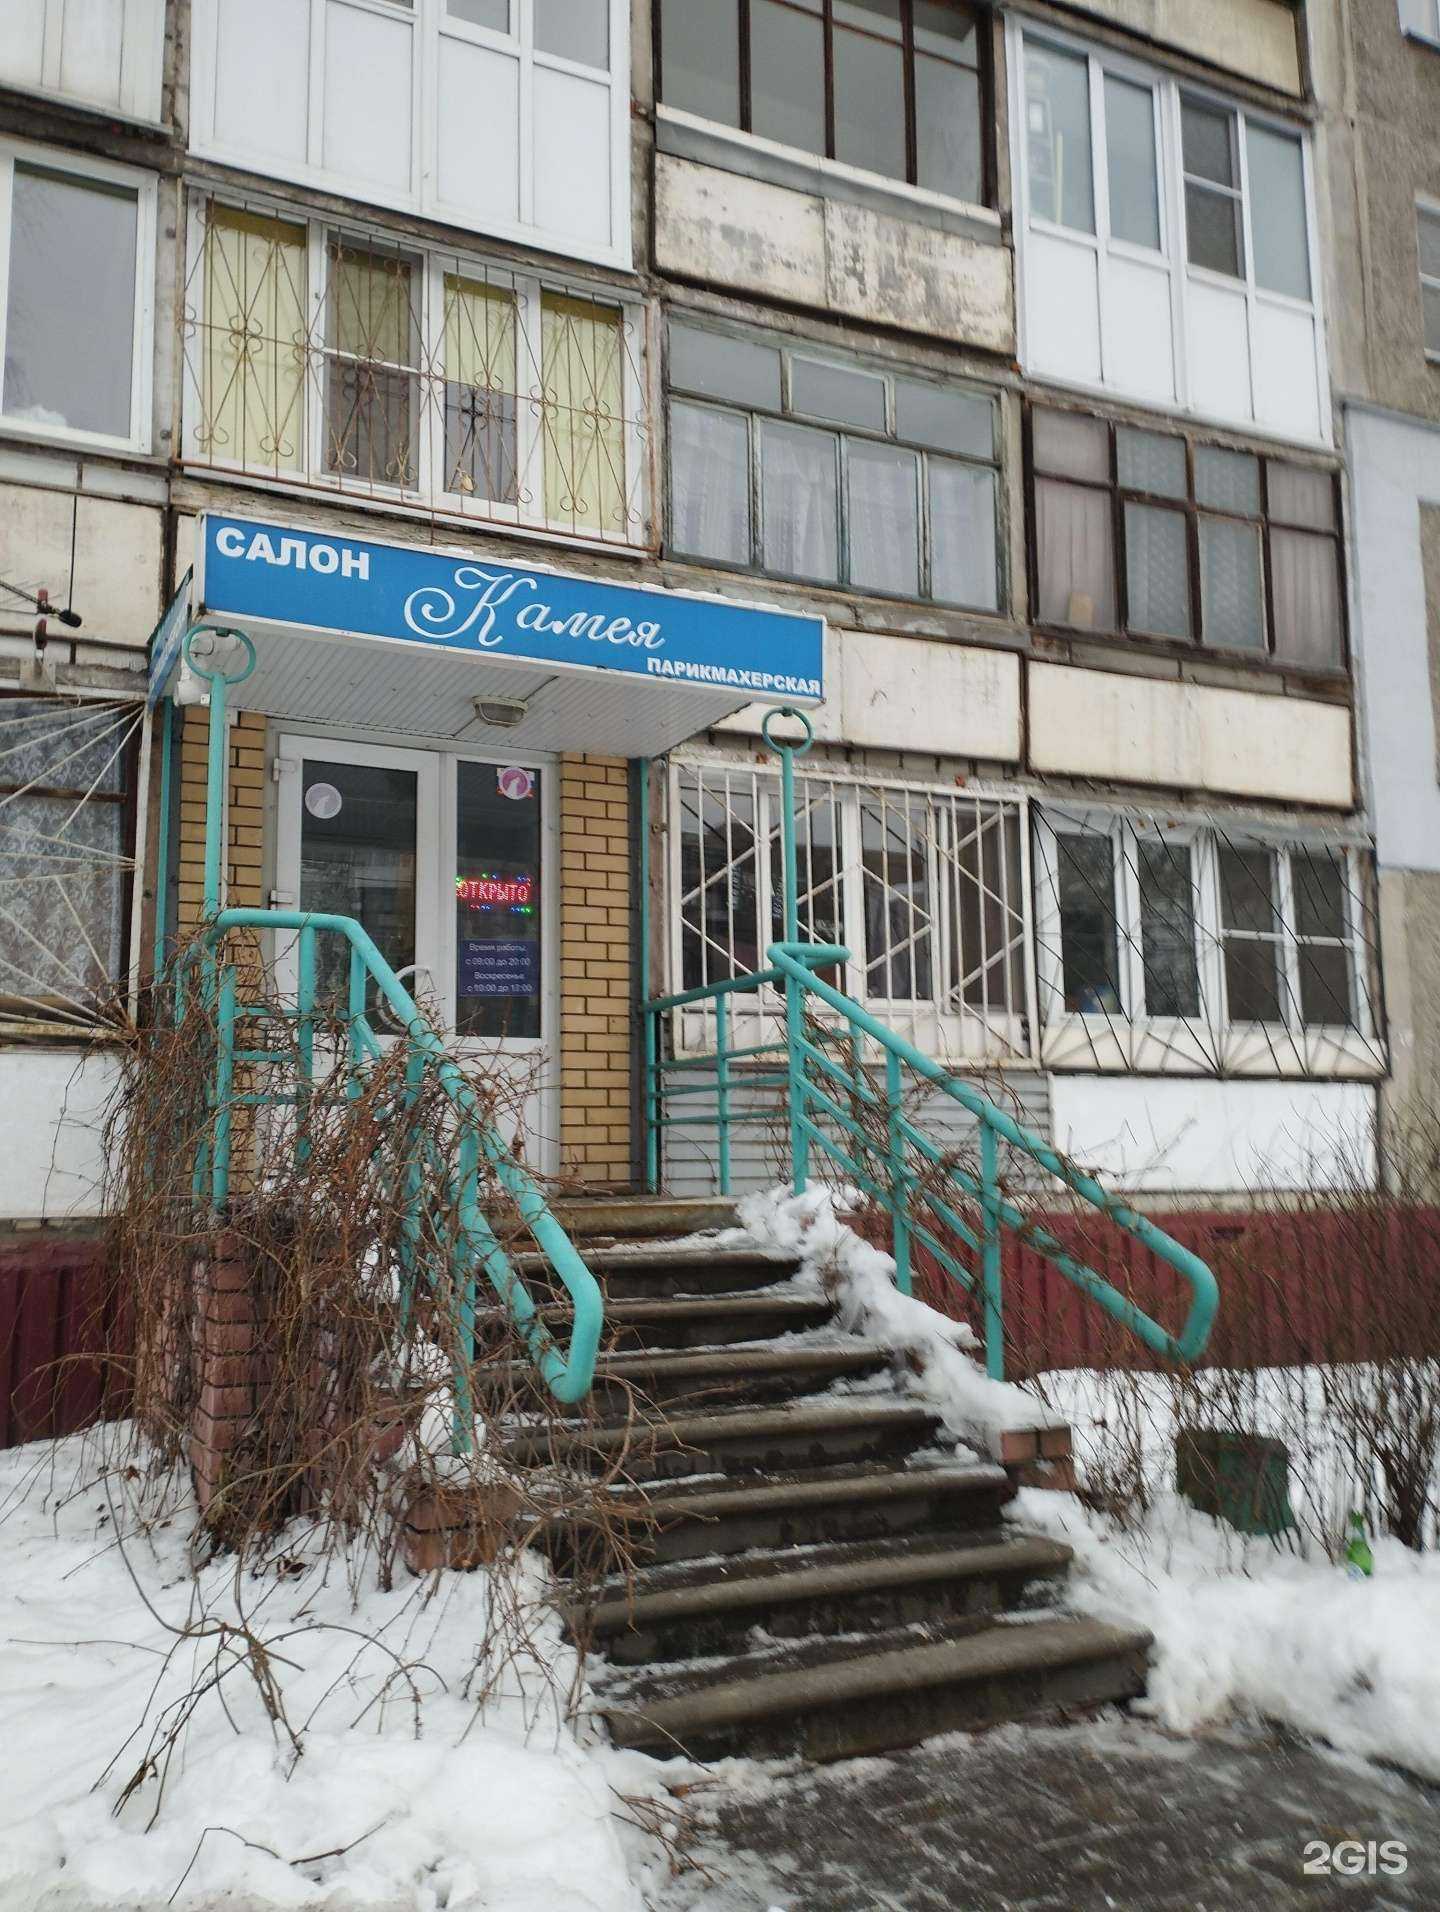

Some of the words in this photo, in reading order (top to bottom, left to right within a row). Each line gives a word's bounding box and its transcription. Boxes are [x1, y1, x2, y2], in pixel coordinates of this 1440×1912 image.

[216, 526, 370, 581] САЛОН
[403, 567, 666, 650] Камея
[646, 656, 822, 695] ПАРИКМАХЕРСКАЯ
[458, 880, 528, 901] ОТКРЫТО
